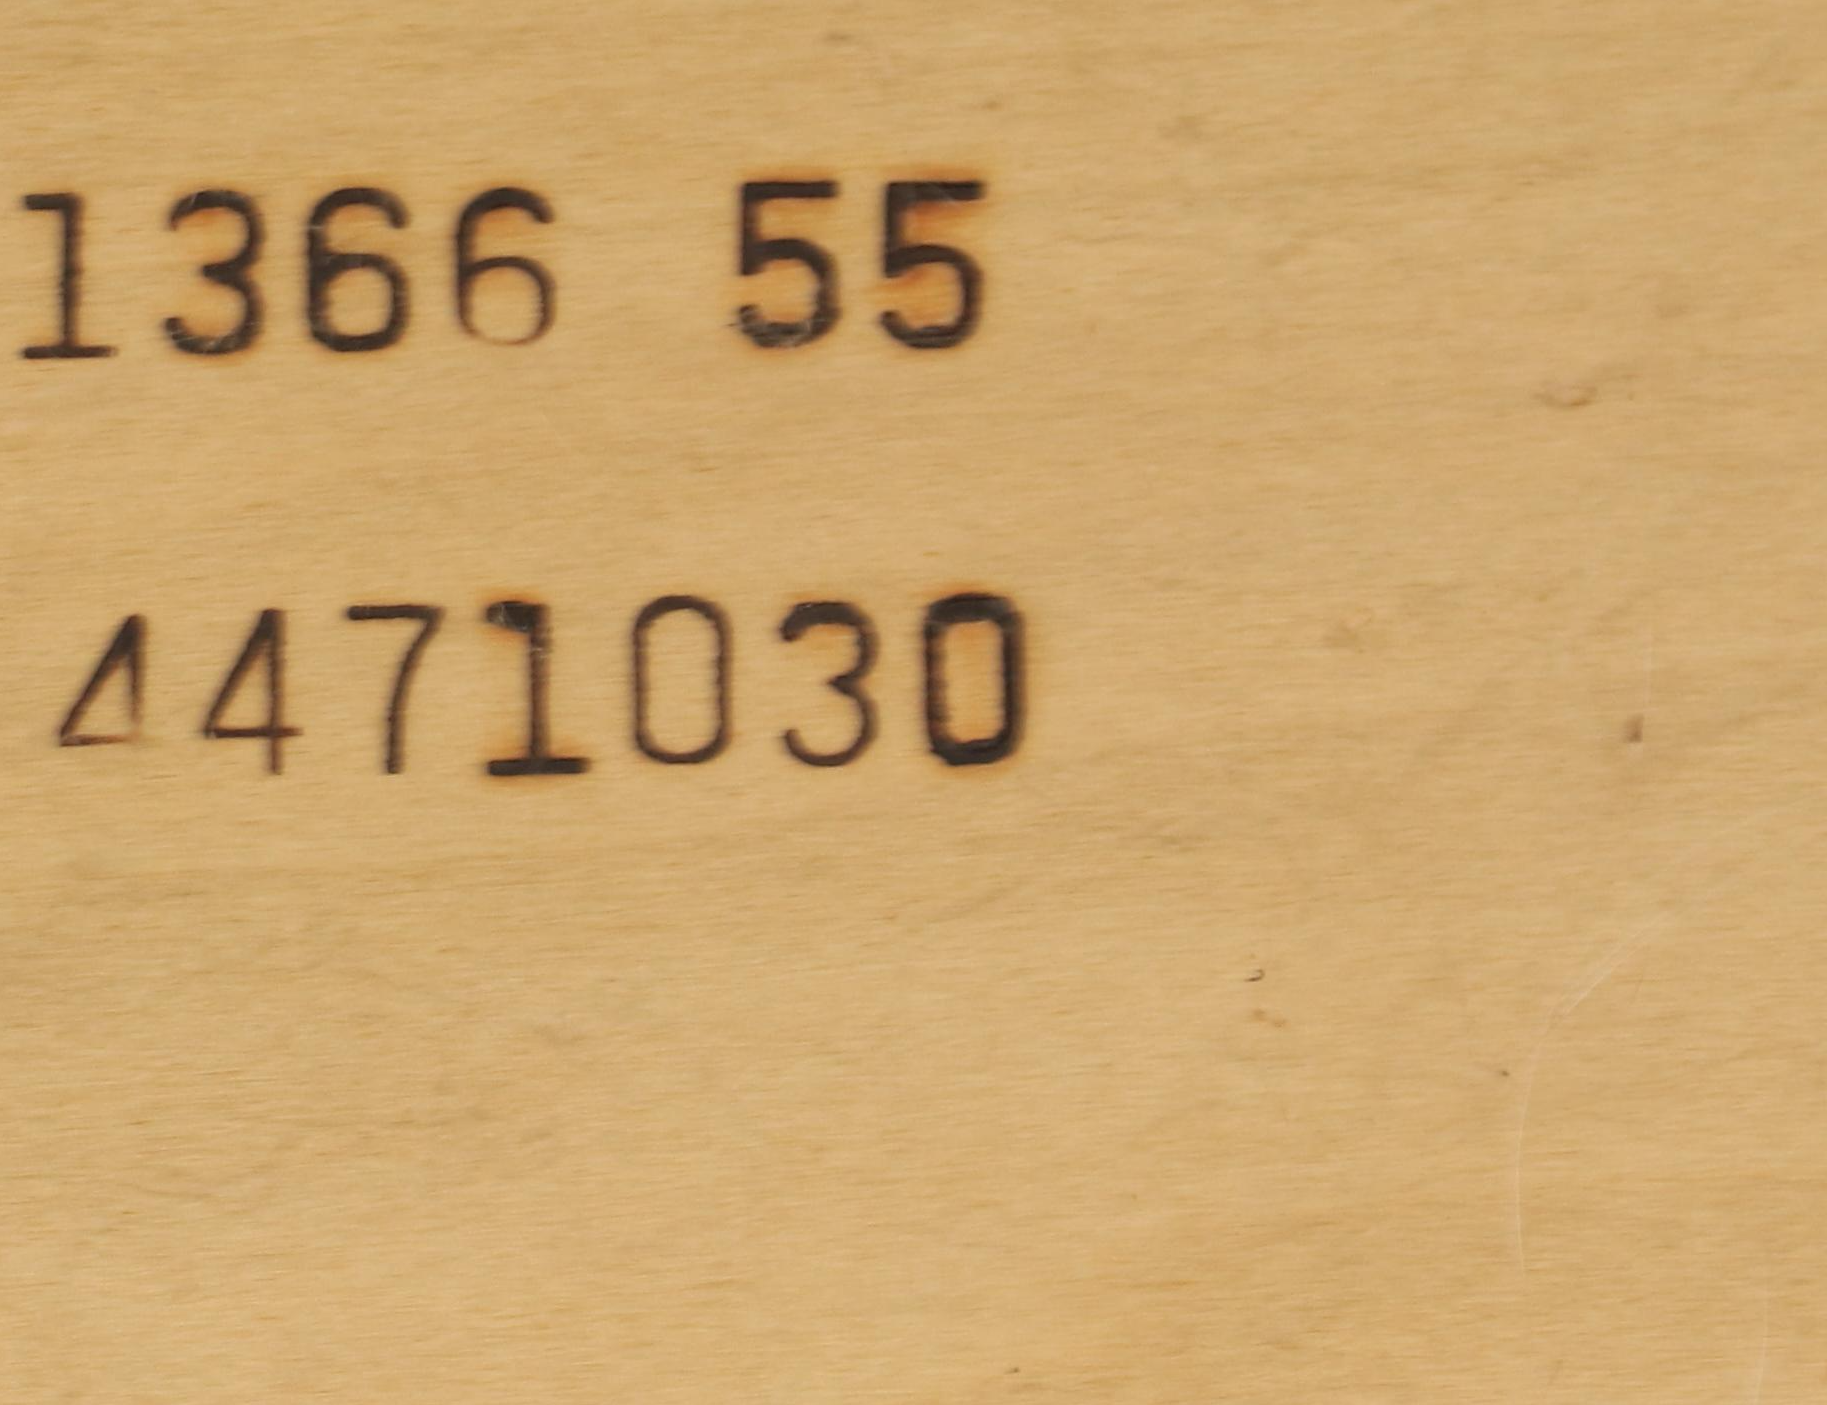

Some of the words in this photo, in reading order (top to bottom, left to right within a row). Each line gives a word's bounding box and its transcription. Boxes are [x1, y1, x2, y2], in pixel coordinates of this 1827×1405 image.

[20, 186, 555, 360] 1366
[732, 178, 986, 351] 55
[58, 592, 1026, 779] 4471030
